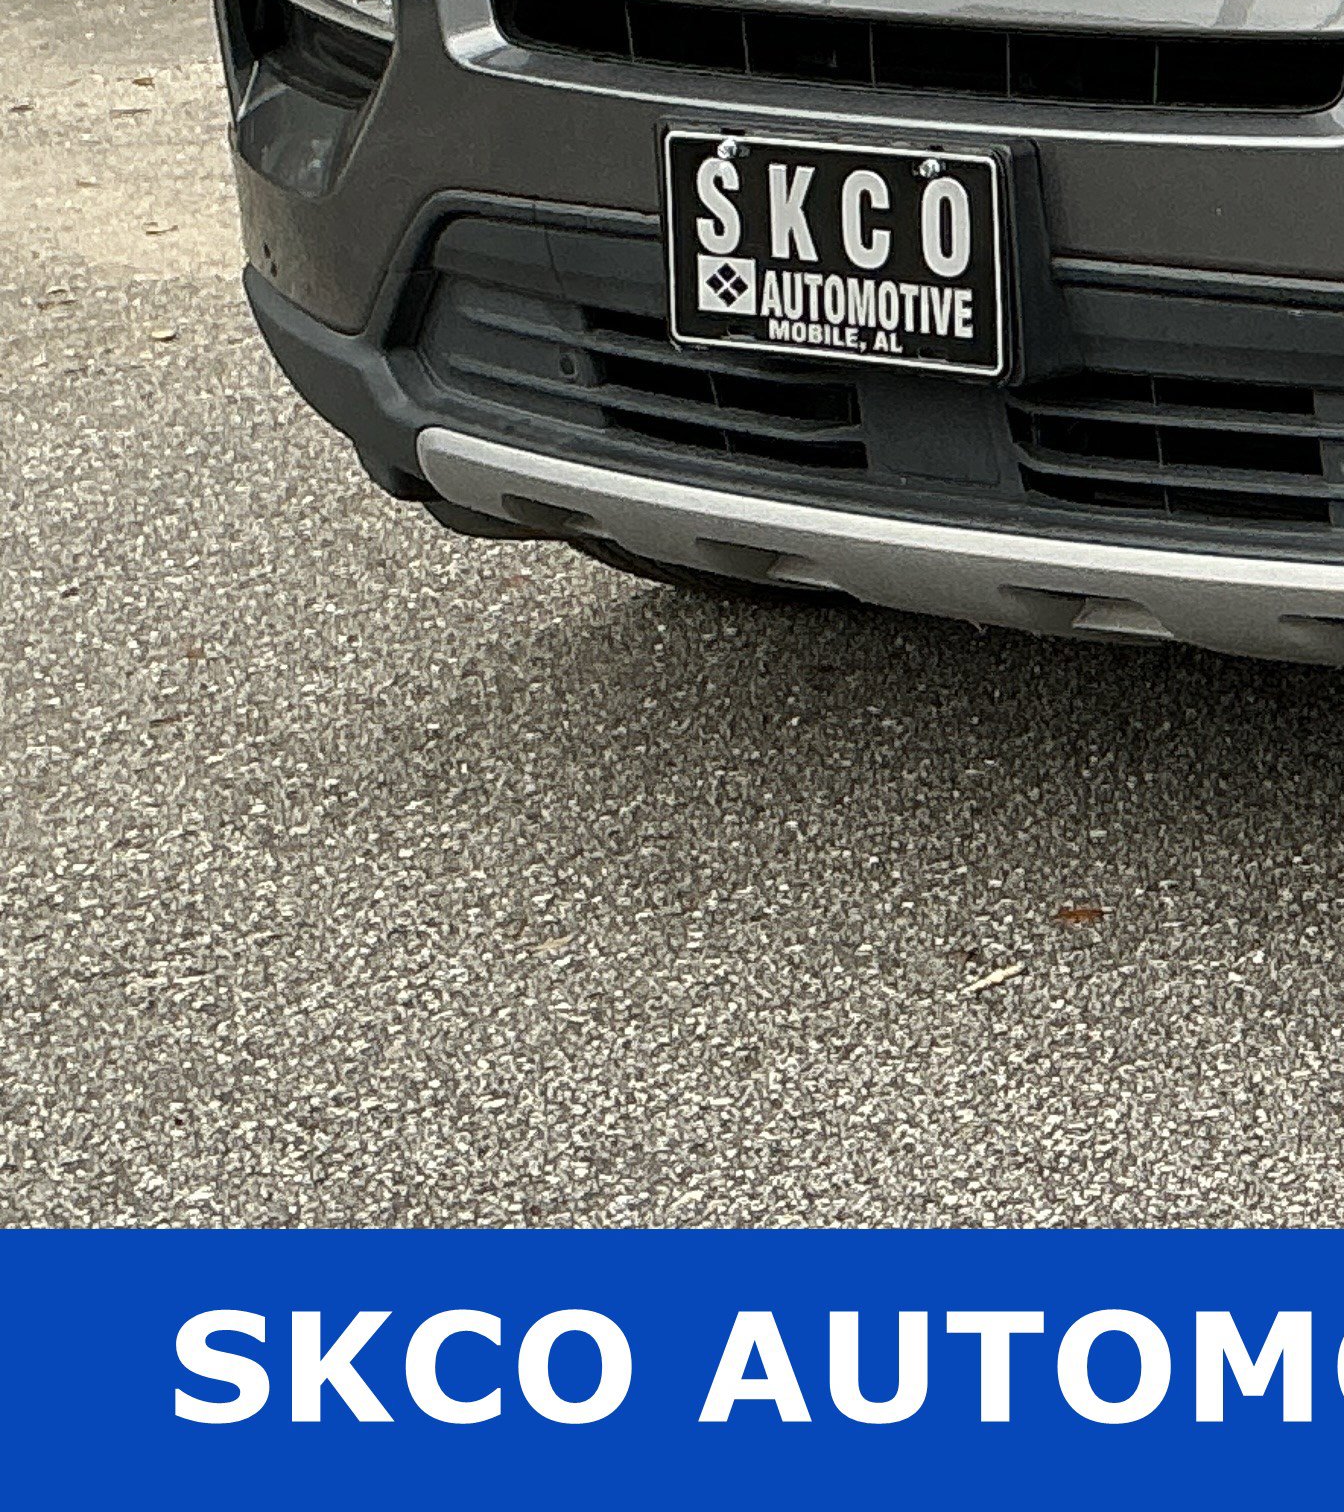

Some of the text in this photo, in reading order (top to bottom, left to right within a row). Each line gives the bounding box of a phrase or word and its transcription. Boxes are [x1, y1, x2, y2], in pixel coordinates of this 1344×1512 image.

[695, 156, 972, 278] SKCO
[760, 269, 974, 339] AUTOMOTIVE
[768, 317, 903, 354] MOBILE, AL
